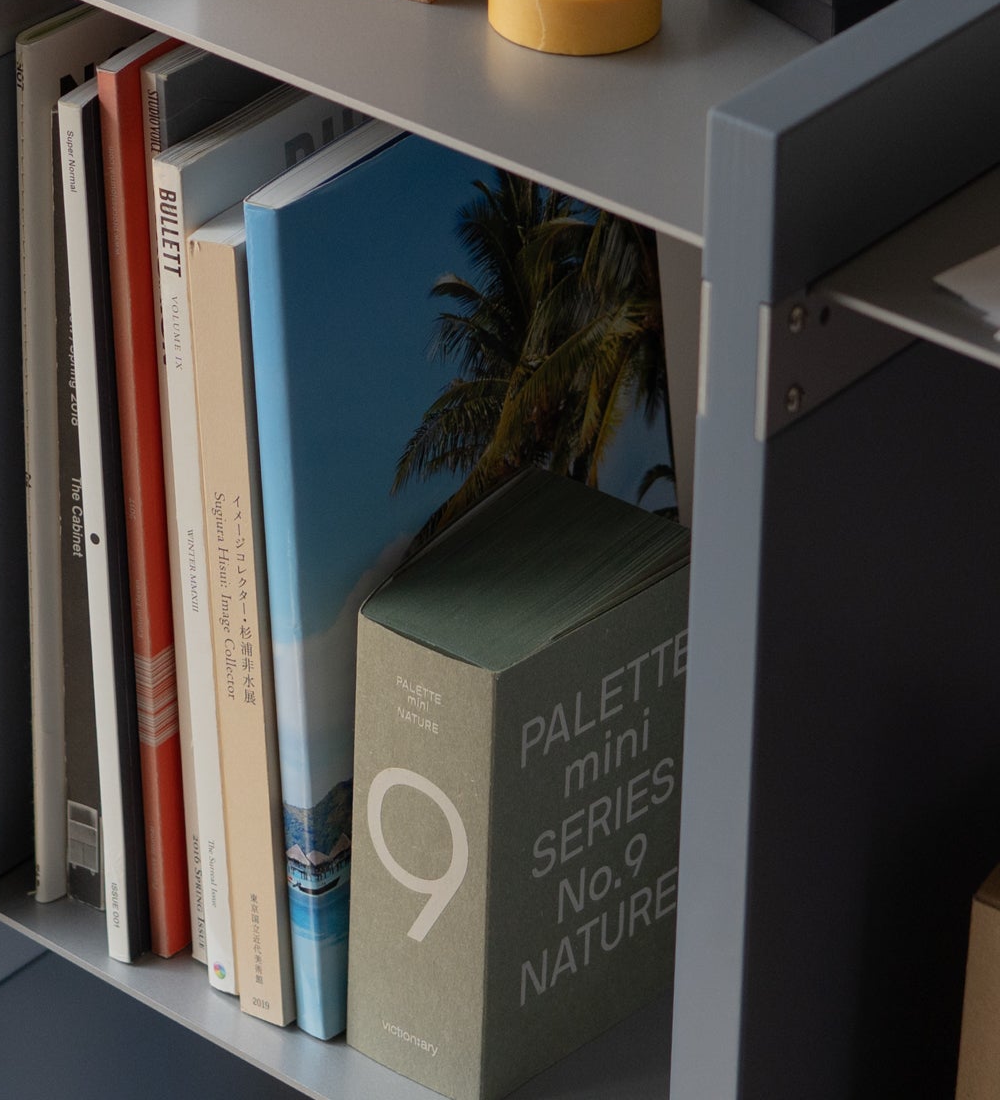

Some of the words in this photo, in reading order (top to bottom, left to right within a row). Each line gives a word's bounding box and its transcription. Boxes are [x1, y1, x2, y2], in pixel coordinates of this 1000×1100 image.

[147, 88, 161, 126] STUDIO
[66, 129, 75, 160] Super
[69, 161, 78, 193] Normal
[158, 186, 182, 277] BULLETT
[170, 295, 183, 351] VOLUME
[174, 354, 183, 371] IX
[71, 476, 82, 502] The
[72, 504, 84, 557] Cabinet
[212, 491, 226, 543] Sugiura
[186, 528, 197, 571] WINTER
[218, 548, 231, 589] Hisui:
[219, 594, 232, 633] Image
[224, 639, 238, 701] Collector
[396, 675, 442, 705] PALETTE
[407, 695, 430, 712] mini
[520, 628, 689, 769] PALETTE
[397, 706, 439, 734] NATURE
[563, 707, 651, 798] mini
[531, 757, 675, 879] SERIES
[191, 835, 202, 864] 2016
[207, 839, 215, 856] The
[366, 766, 468, 942] 9
[208, 856, 218, 888] Surreal
[110, 881, 120, 908] ISSUE
[113, 909, 122, 929] 001
[519, 866, 679, 1007] NATURE
[252, 996, 270, 1011] 2019
